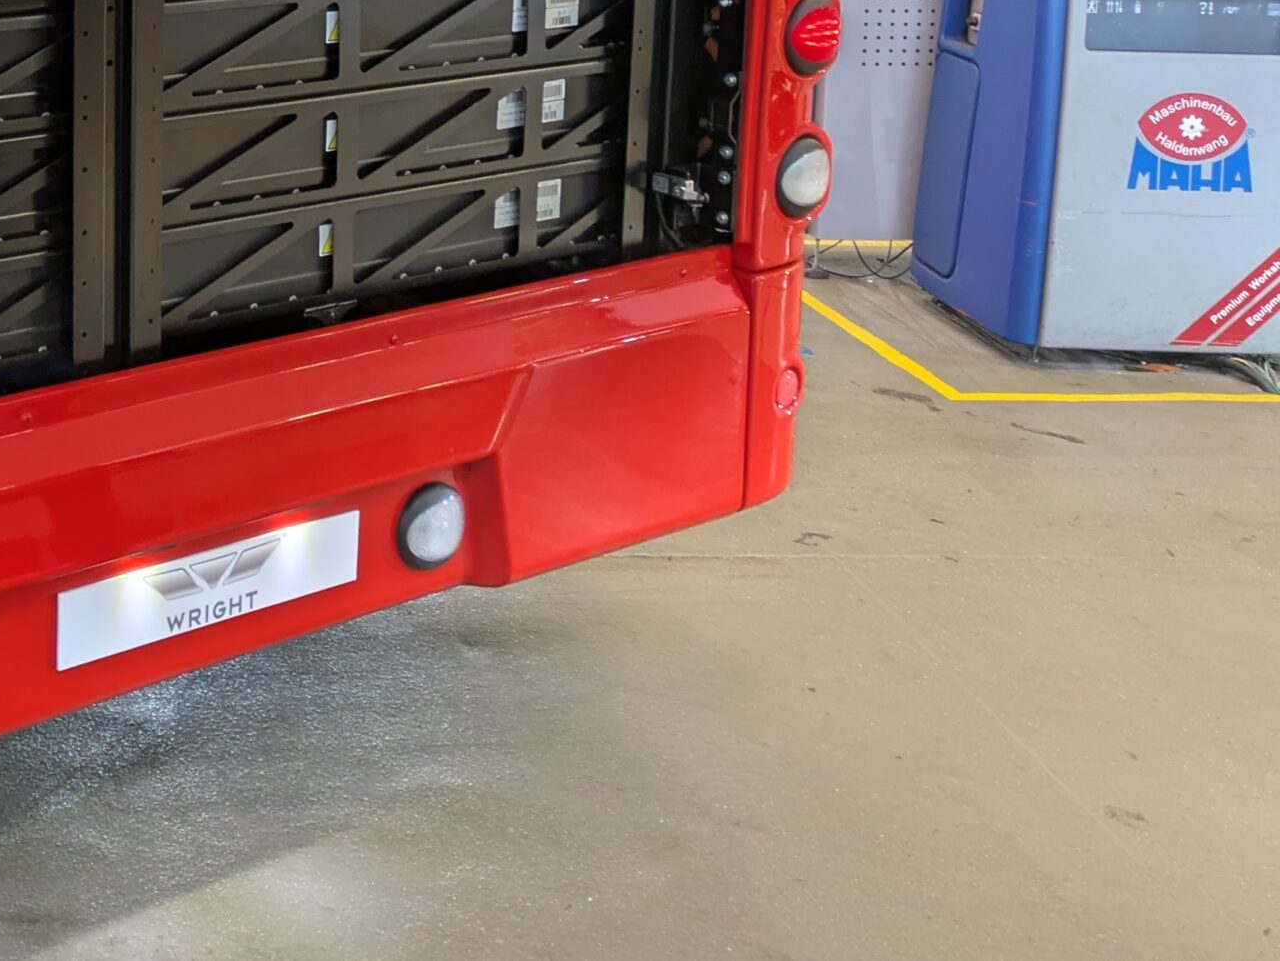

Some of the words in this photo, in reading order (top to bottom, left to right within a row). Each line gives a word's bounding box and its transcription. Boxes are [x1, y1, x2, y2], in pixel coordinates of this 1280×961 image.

[1147, 96, 1238, 127] Maschinenbau
[1154, 131, 1230, 157] Haldenwang
[1126, 135, 1253, 193] MAHA
[1209, 289, 1251, 325] Premium
[166, 590, 258, 634] WRIGHT
